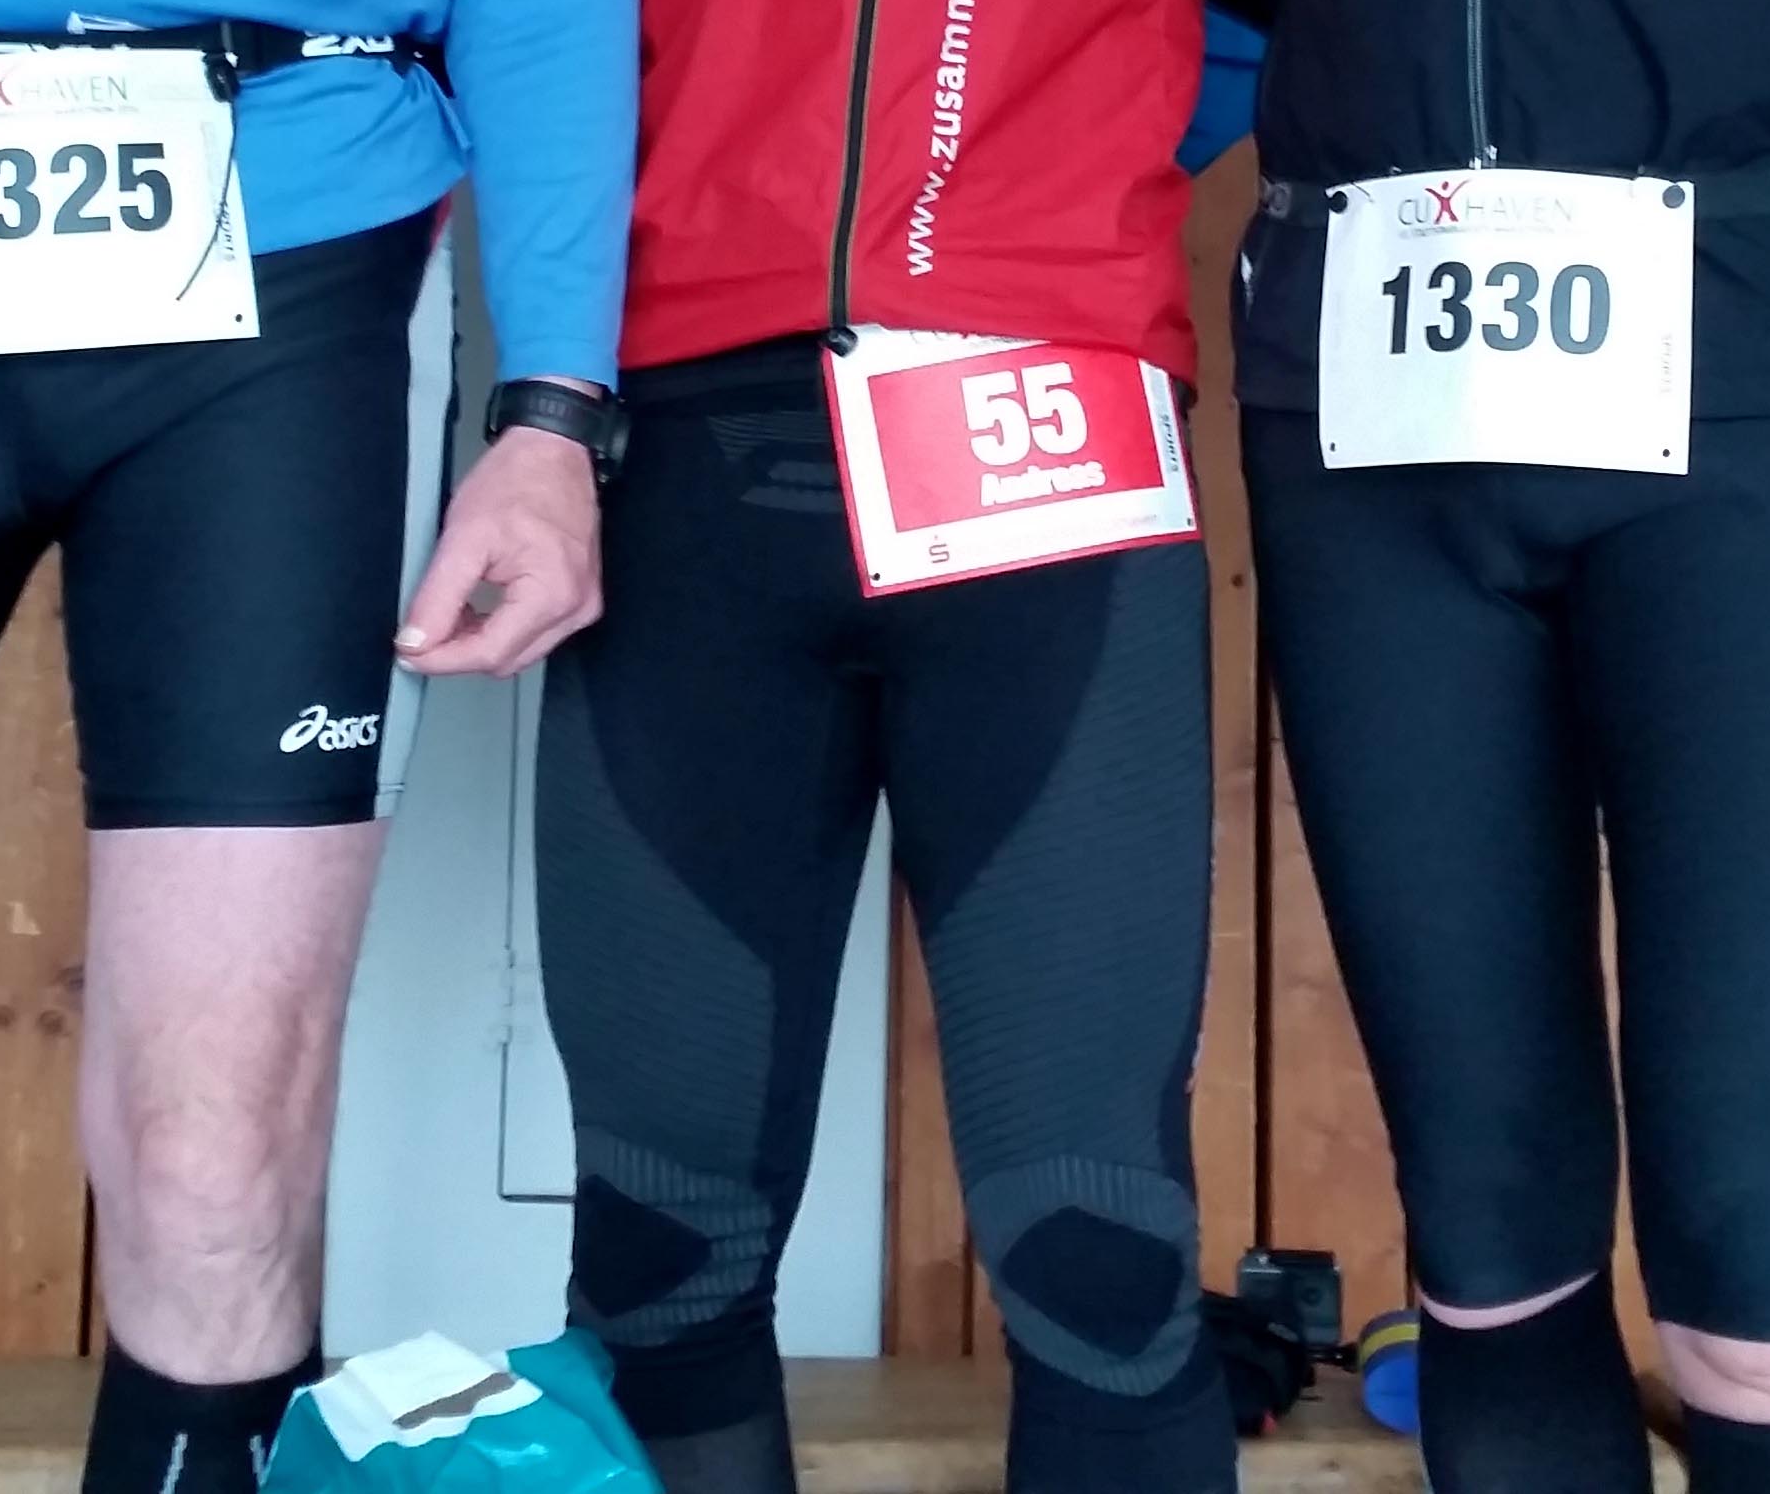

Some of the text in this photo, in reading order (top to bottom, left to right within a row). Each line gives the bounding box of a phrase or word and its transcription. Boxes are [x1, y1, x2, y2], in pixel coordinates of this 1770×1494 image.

[1382, 261, 1611, 355] 1330
[960, 362, 1088, 467] 55
[980, 460, 1107, 508] Andreas
